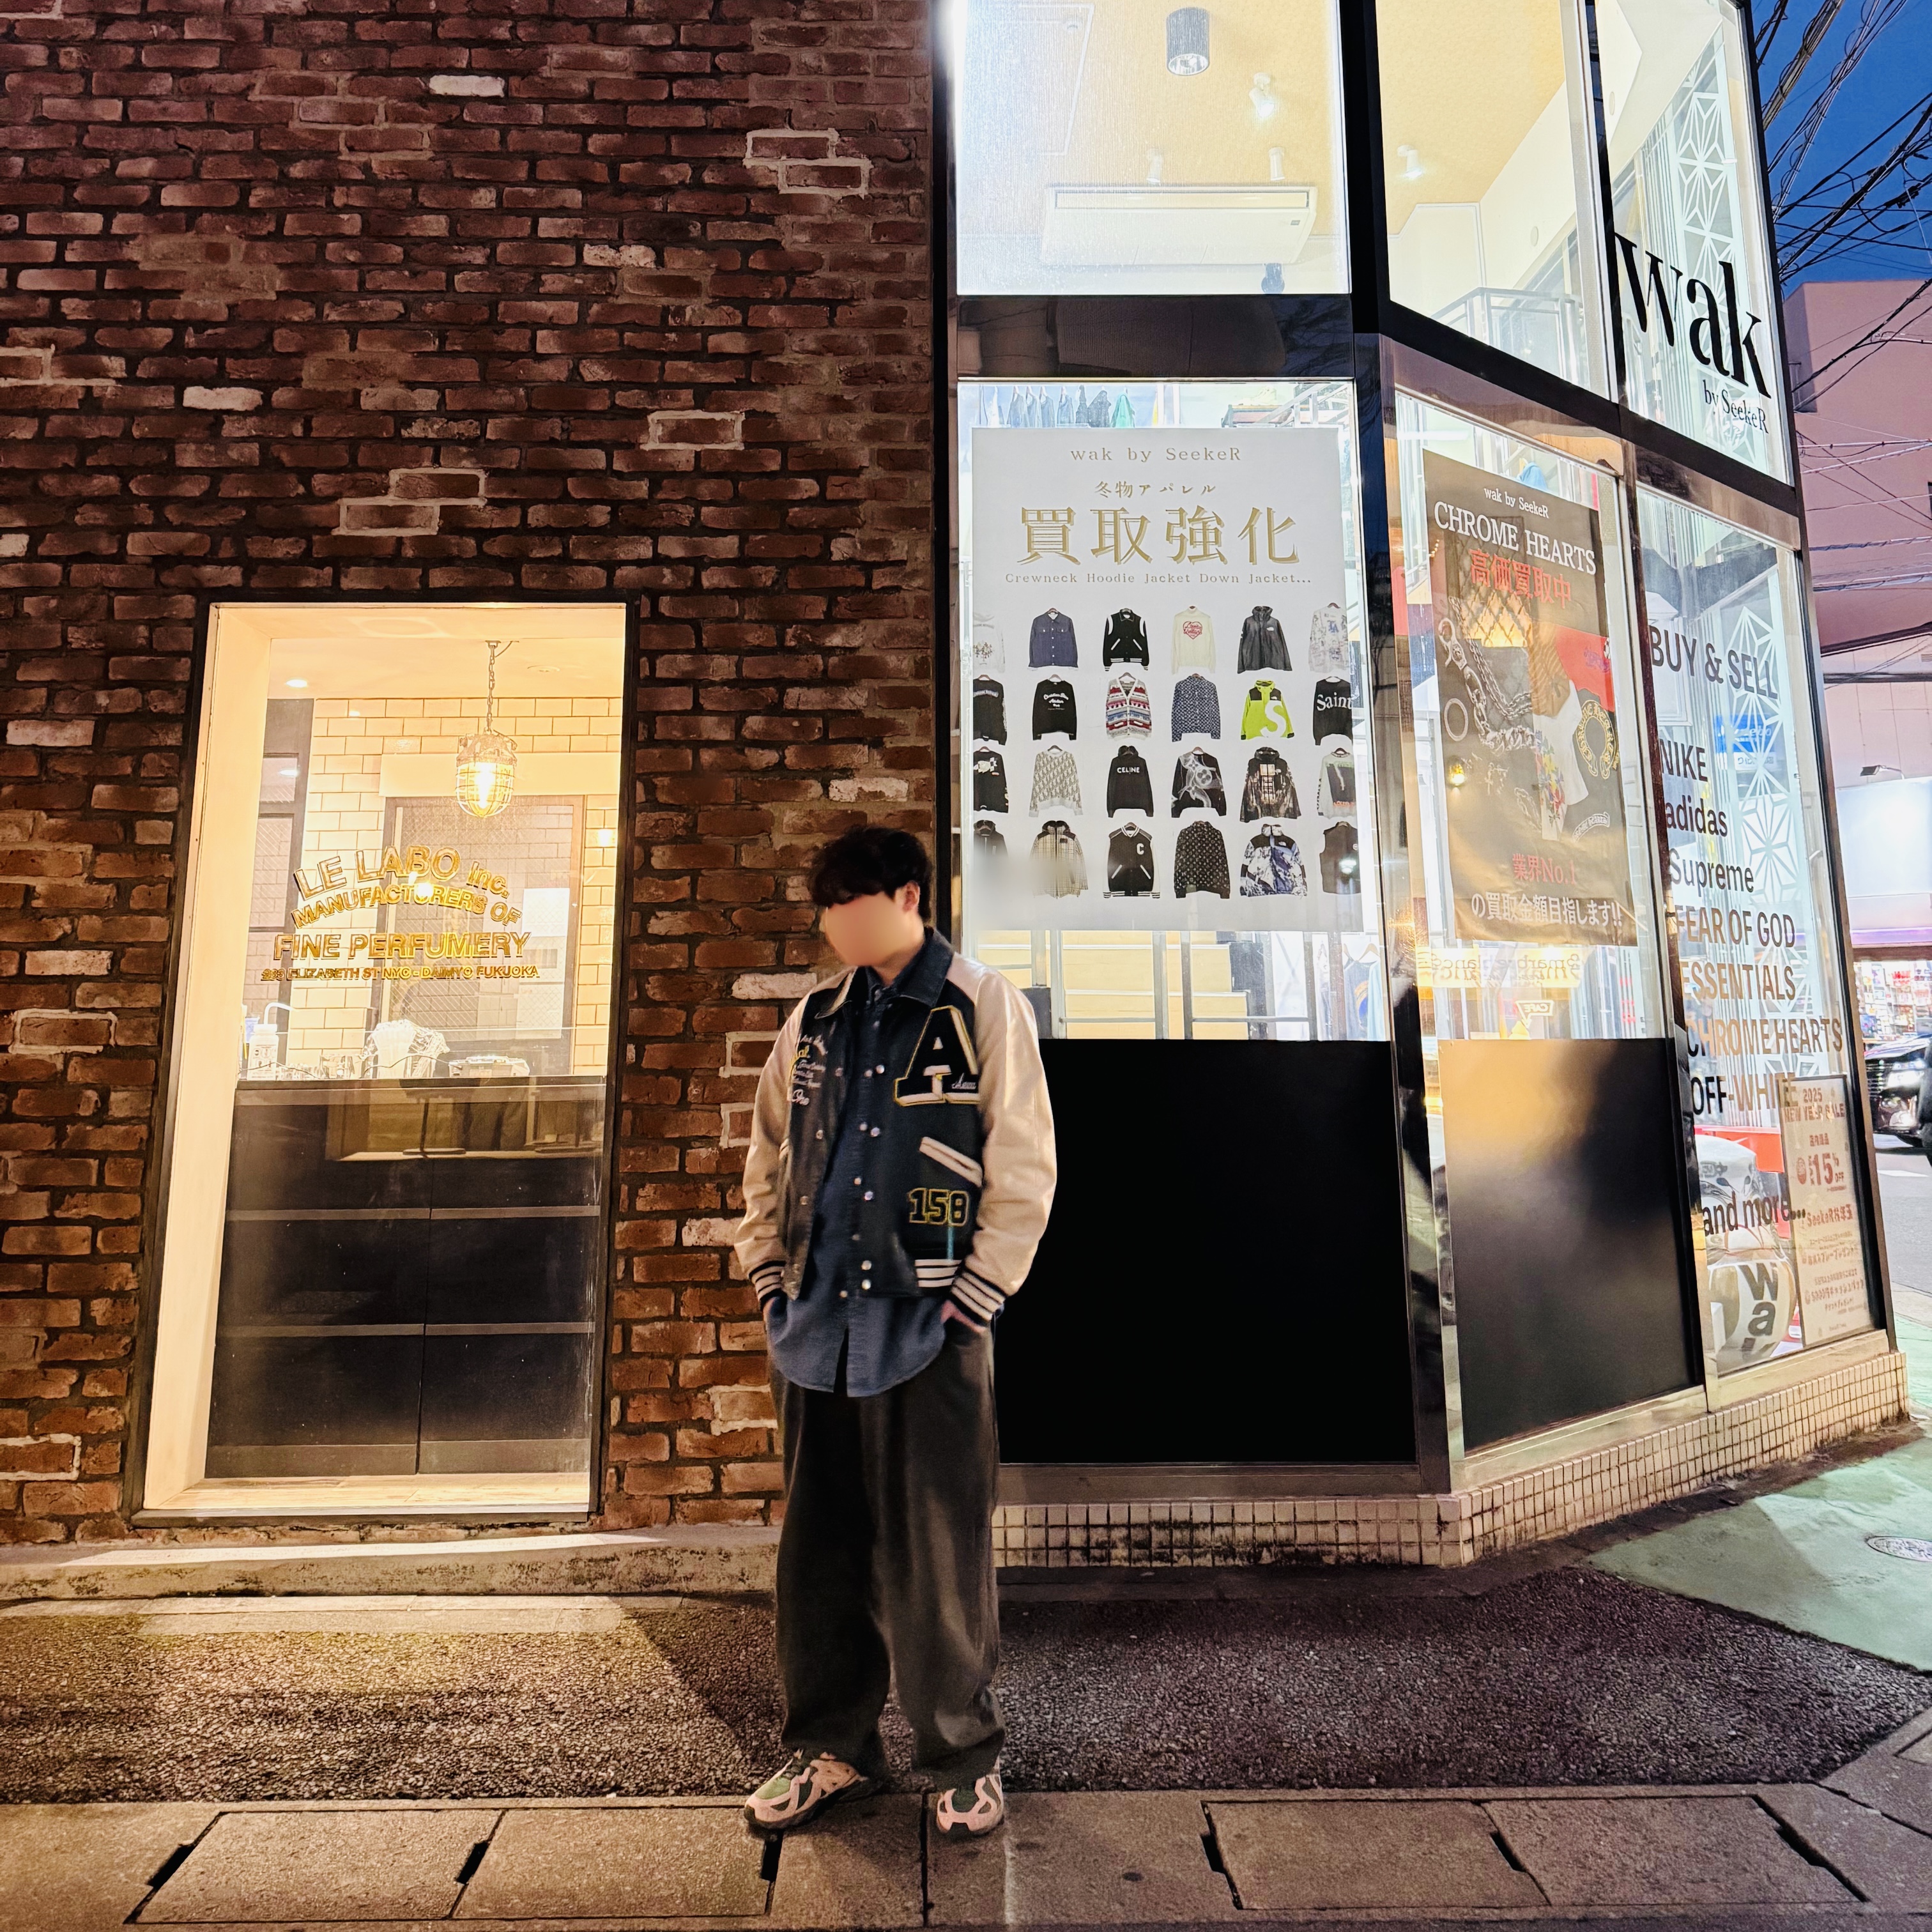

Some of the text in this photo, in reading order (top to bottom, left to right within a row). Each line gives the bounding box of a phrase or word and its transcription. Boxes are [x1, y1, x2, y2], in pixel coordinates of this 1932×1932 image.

[1721, 388, 1769, 434] SeekeR
[1071, 447, 1241, 463] wak by SeekeR
[1094, 480, 1216, 498] 冬物アパレル
[1483, 488, 1549, 519] wak by SeekeR
[1016, 505, 1300, 565] 買取強化
[1434, 502, 1596, 575] CHROME HEARTS
[1006, 573, 1311, 584] Crewneck Hoodie Jacket Down Jacket...
[1469, 549, 1571, 609] 高価買取中
[1648, 625, 1777, 700] BUY & SELL
[1659, 739, 1708, 782] NIKE
[1666, 795, 1728, 838] adidas
[293, 845, 510, 900] LE LABO Inc.
[1513, 854, 1576, 885] 業界No.1
[1669, 848, 1754, 897] Supreme
[490, 904, 523, 926] OF
[1675, 905, 1795, 947] FEAR OF GOD
[274, 931, 532, 960] FINE PERFUMERY
[261, 968, 285, 981] 233
[287, 967, 359, 981] ELIZABETH
[381, 966, 411, 979] NYC
[420, 965, 473, 979] DAIMYO
[476, 965, 540, 979] FUKUOKA
[1680, 961, 1796, 1000] ESSENTIALS
[894, 1005, 980, 1107] A
[1686, 1018, 1843, 1057] CHROME HEARTS
[1803, 1087, 1822, 1103] 2025
[907, 1188, 969, 1227] 158
[1703, 1190, 1739, 1236] and
